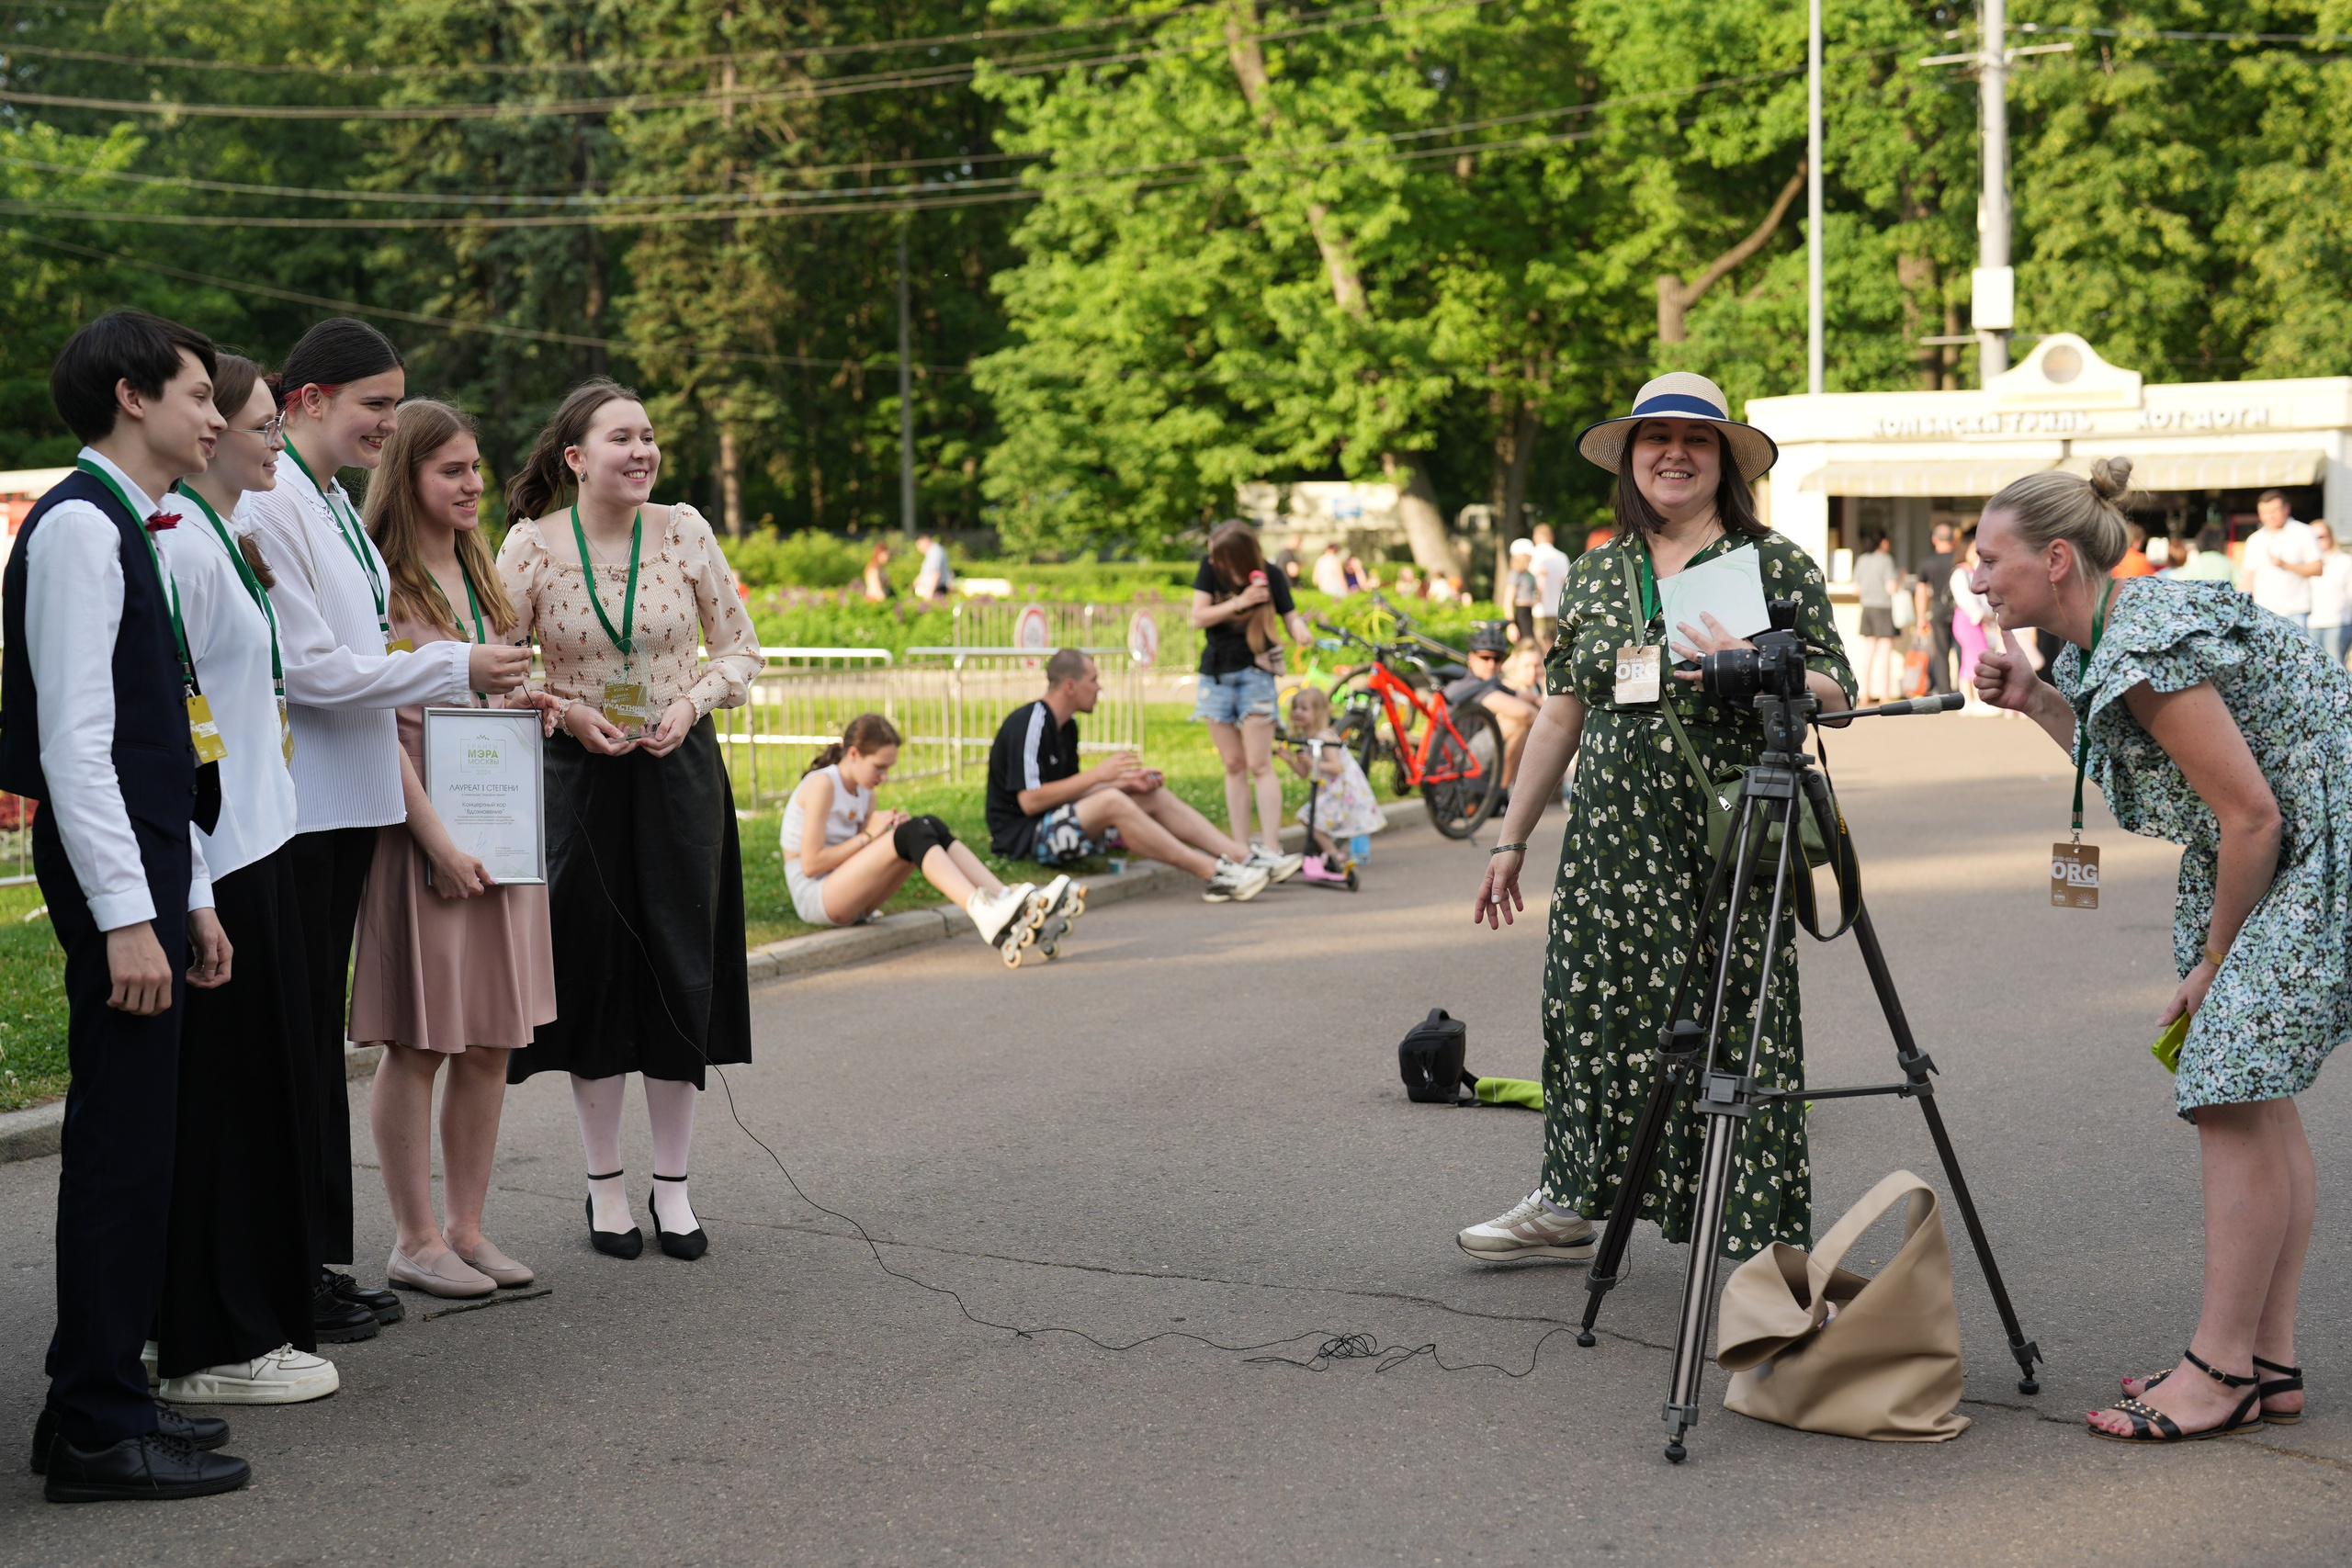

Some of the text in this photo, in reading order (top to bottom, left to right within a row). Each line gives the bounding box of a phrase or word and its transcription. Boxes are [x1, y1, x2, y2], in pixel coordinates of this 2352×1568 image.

[1617, 661, 1659, 681] ORG
[604, 703, 645, 712] УЧАСТНИК
[468, 750, 498, 759] МЭРА
[2052, 862, 2098, 882] ORG
